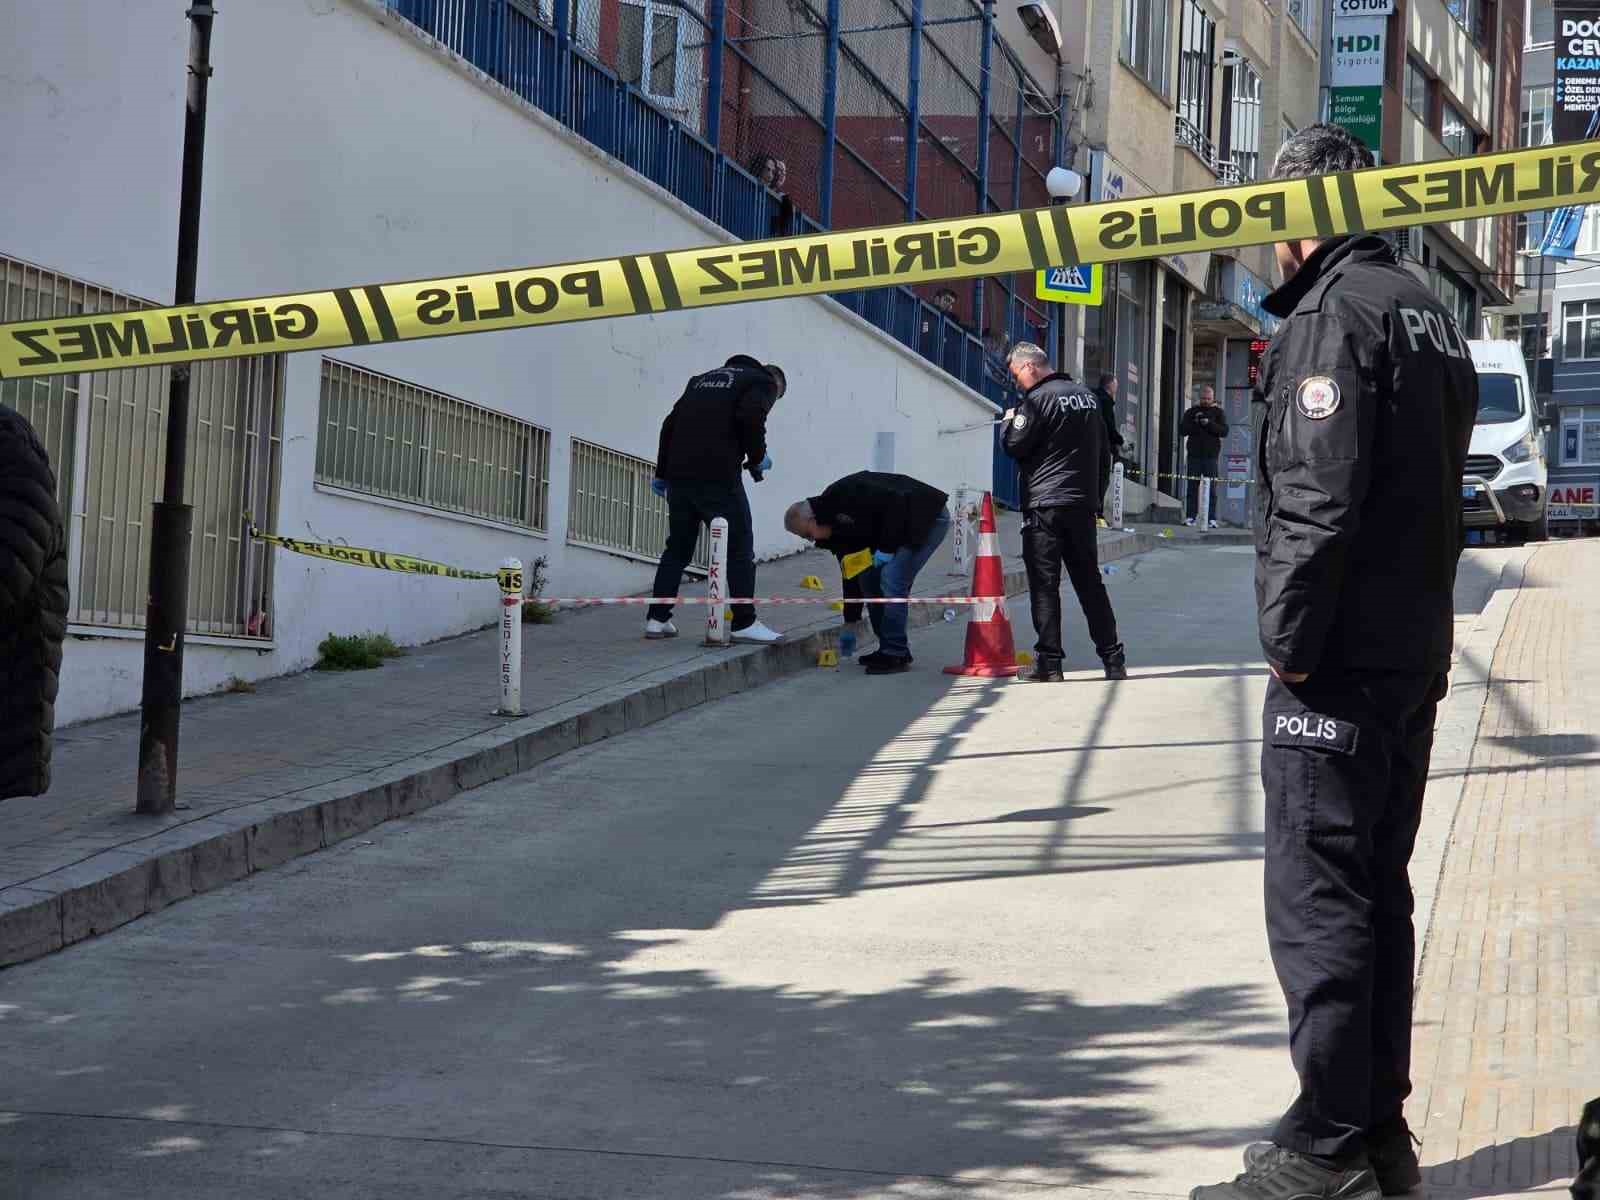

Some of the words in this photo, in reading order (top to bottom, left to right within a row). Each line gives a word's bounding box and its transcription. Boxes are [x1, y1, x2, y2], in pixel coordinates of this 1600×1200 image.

[1337, 34, 1380, 53] HDI
[1336, 56, 1380, 67] Sigorta
[1564, 85, 1585, 94] ÖZEL
[1564, 95, 1597, 104] KOÇLUK
